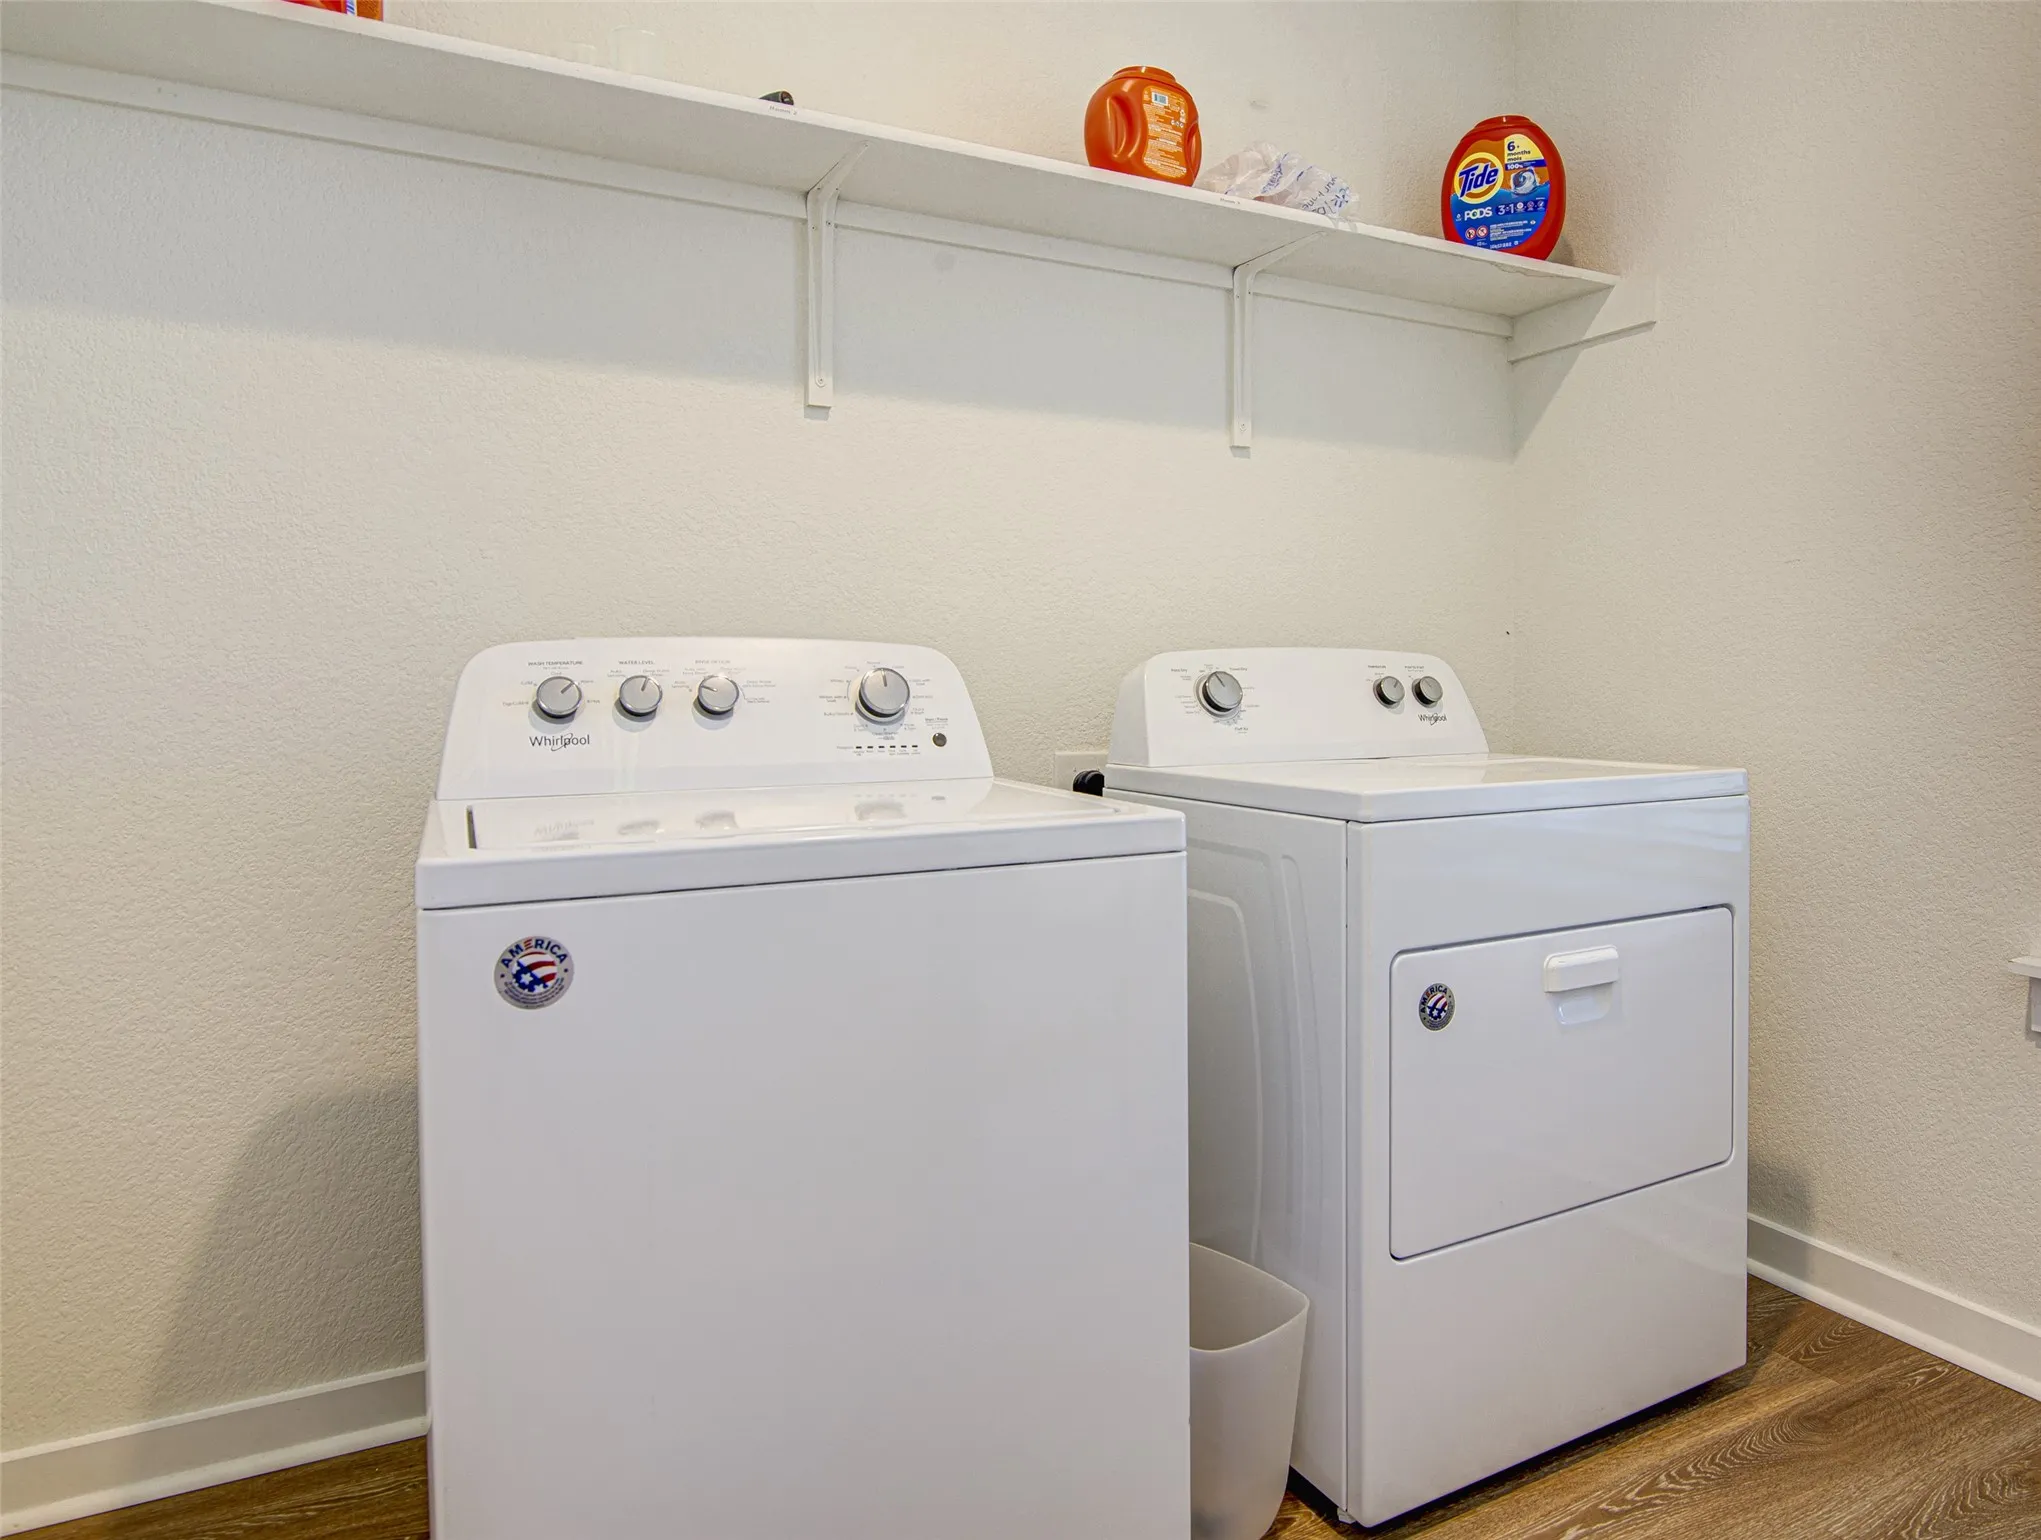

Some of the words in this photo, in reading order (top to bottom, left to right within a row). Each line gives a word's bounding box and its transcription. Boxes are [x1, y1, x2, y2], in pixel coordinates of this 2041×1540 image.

[1458, 163, 1499, 199] Tide
[1464, 206, 1493, 222] PODS
[1418, 713, 1447, 726] Whirlpool
[529, 733, 590, 751] Whirlpool
[500, 938, 568, 969] AMERICA
[1420, 984, 1448, 1014] AMERICA
